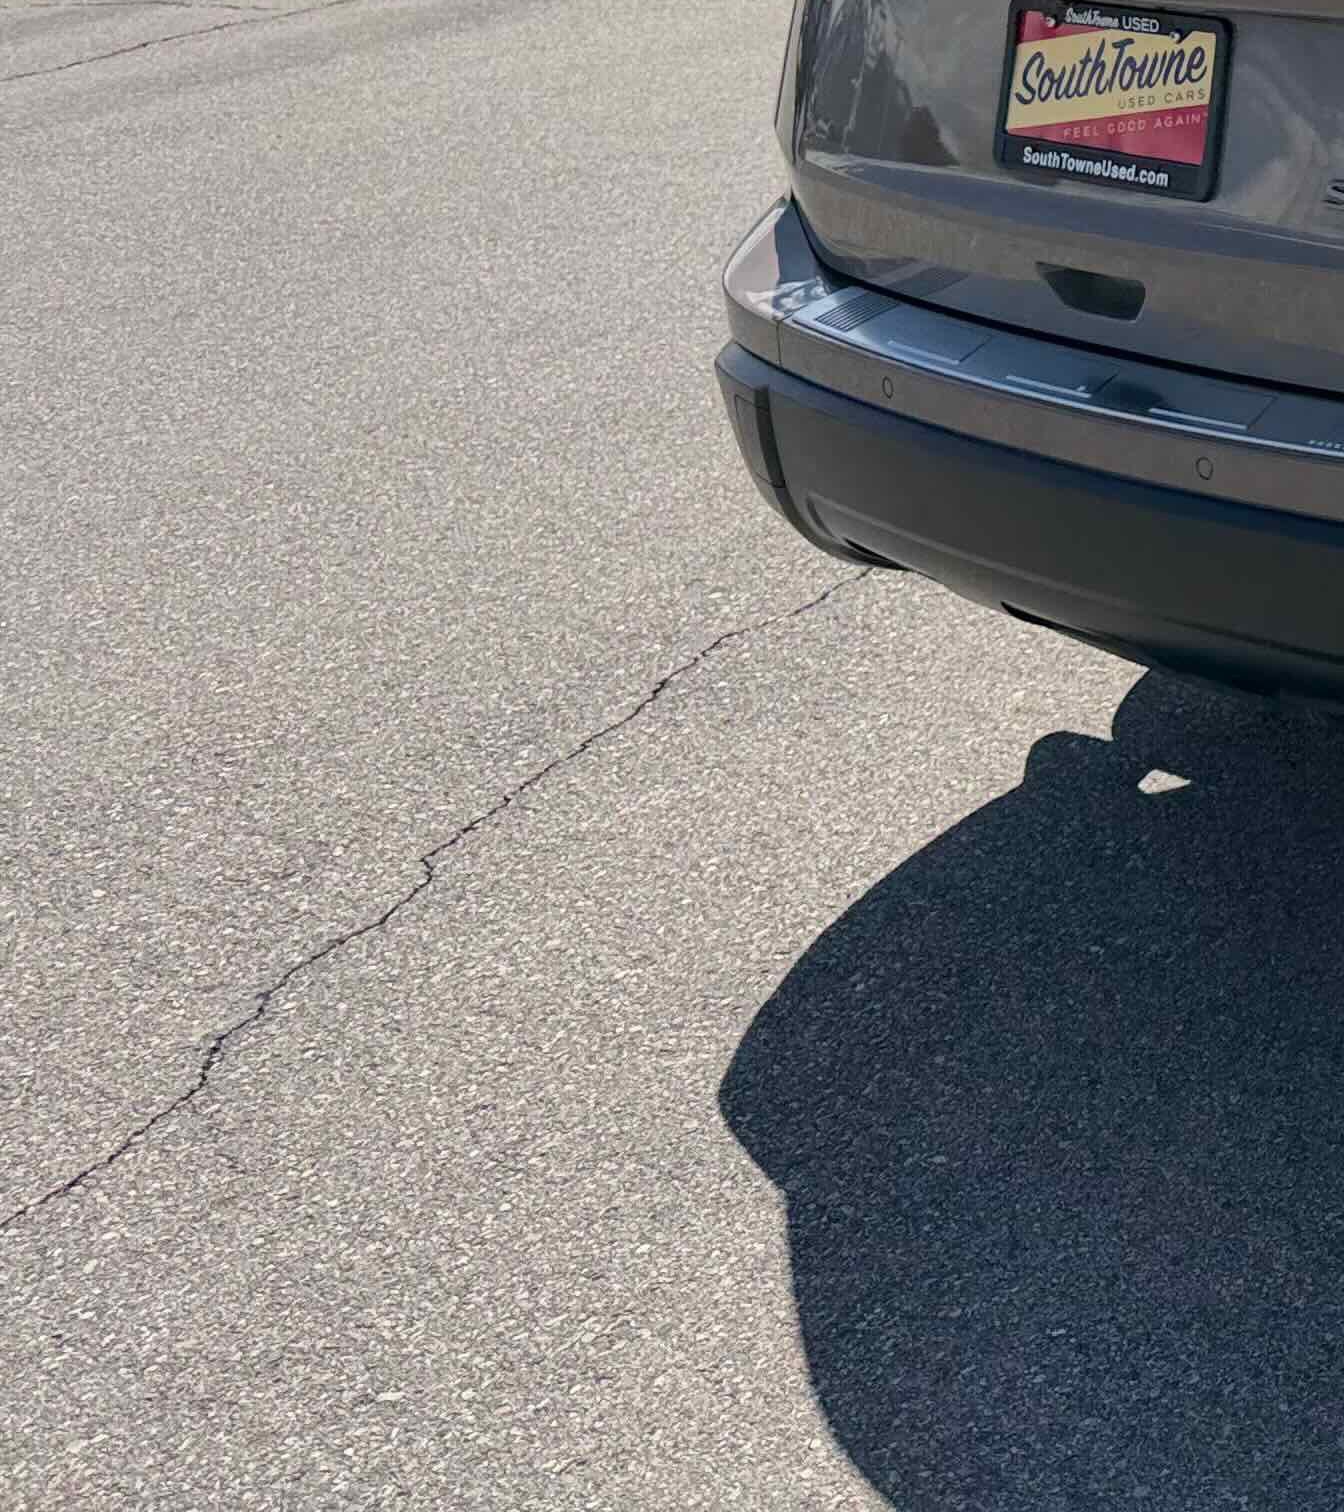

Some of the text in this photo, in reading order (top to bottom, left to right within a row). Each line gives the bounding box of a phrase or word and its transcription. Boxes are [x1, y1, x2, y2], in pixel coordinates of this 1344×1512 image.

[1122, 15, 1160, 33] USED
[1015, 38, 1207, 105] SouthTowne
[1117, 88, 1206, 110] USED CARS
[1063, 125, 1100, 139] FEEL
[1107, 119, 1146, 135] GOOD
[1023, 146, 1169, 187] SouthTowneUsed.com
